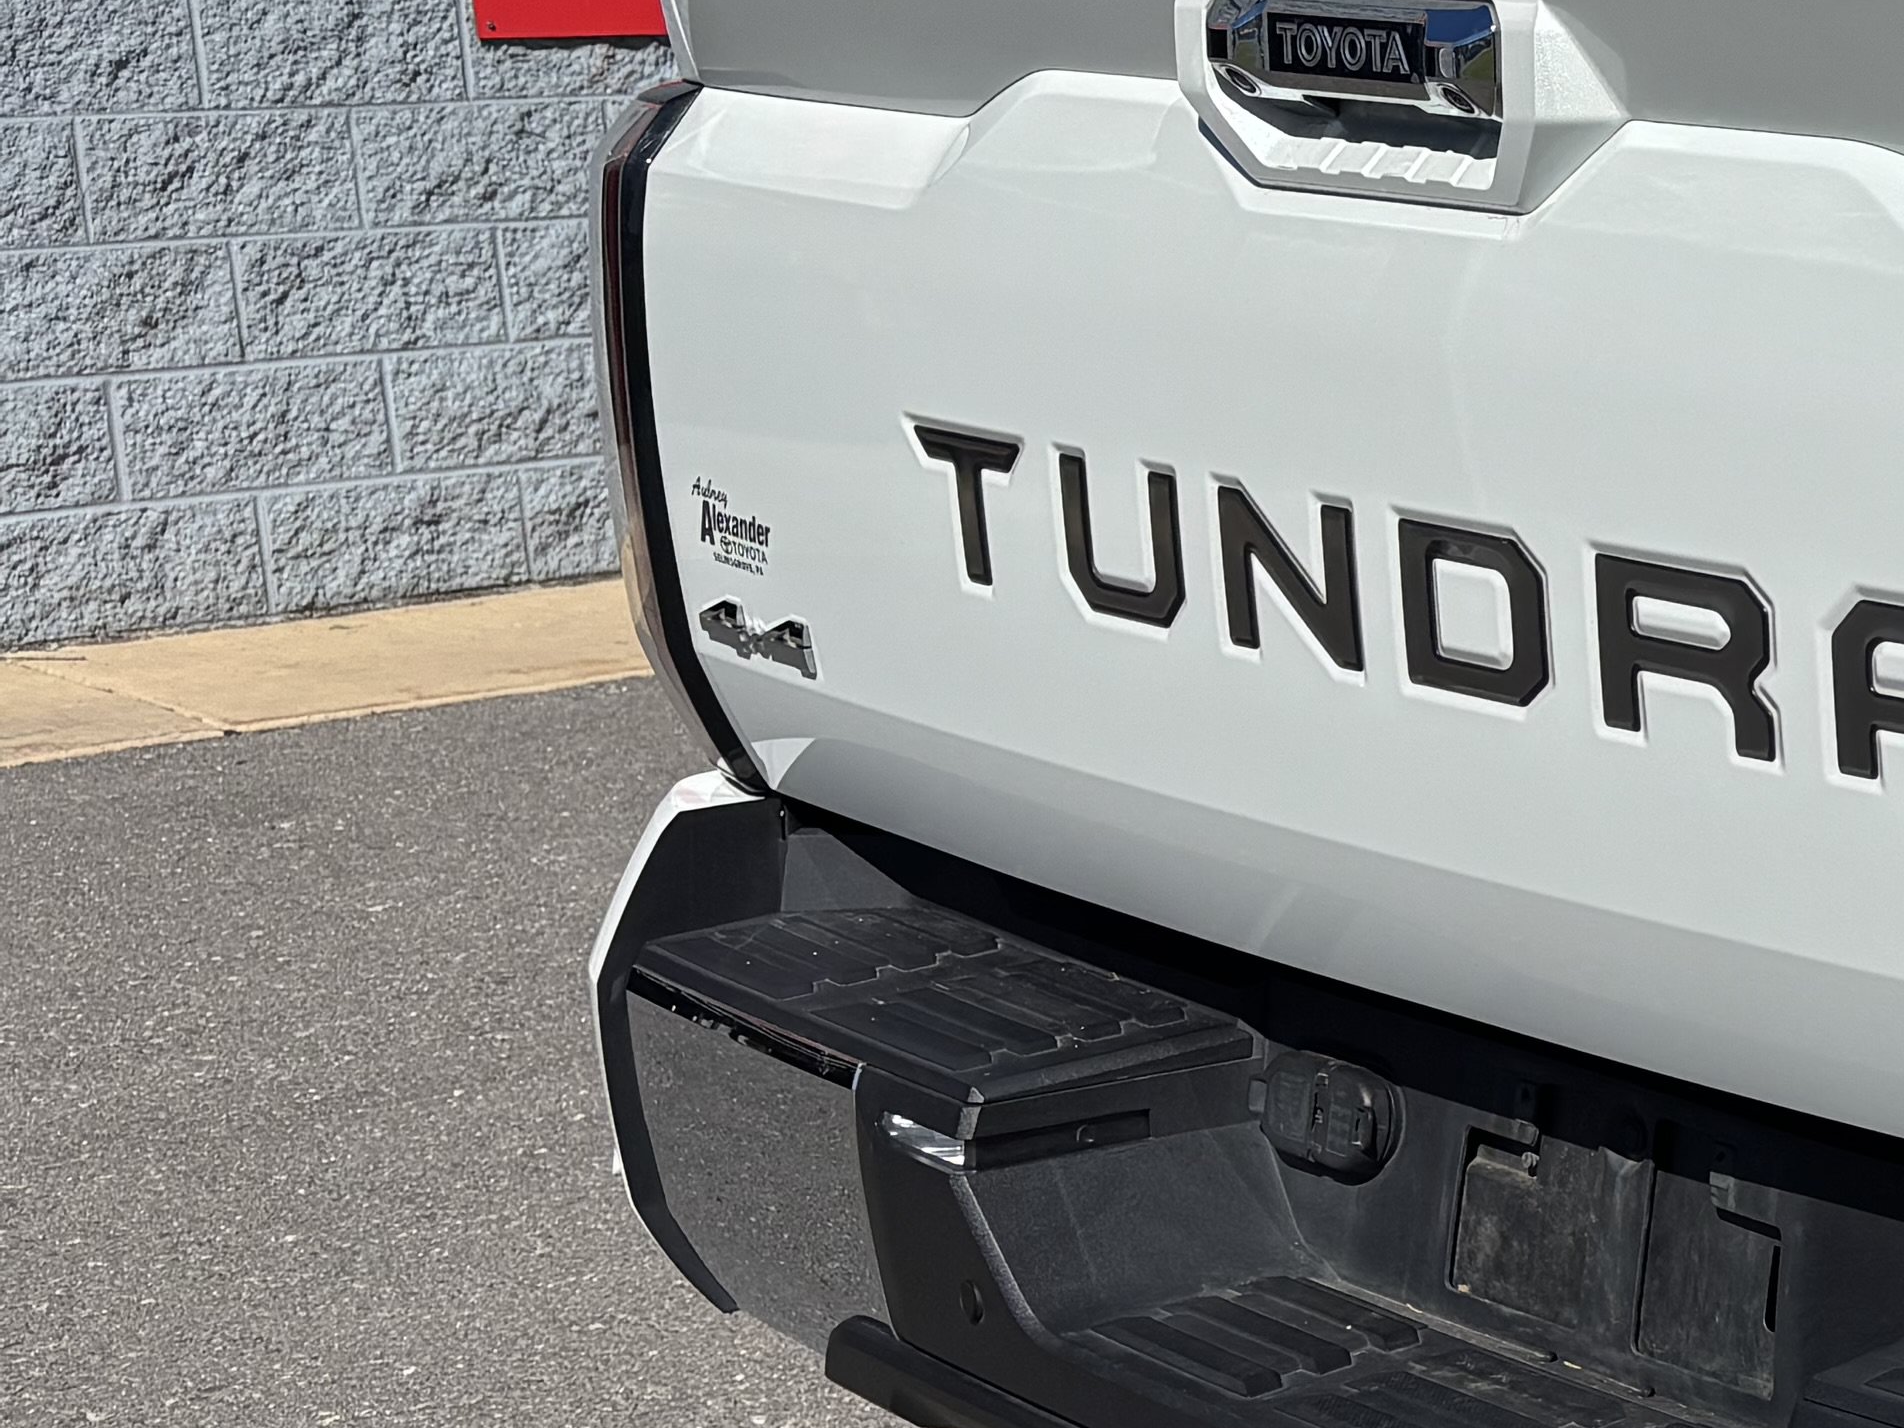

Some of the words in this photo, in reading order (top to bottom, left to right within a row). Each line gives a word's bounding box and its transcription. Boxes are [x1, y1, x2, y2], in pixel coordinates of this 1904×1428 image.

[1276, 21, 1411, 75] TOYOTA
[700, 499, 771, 548] Alexander
[732, 540, 769, 565] TOYOTA
